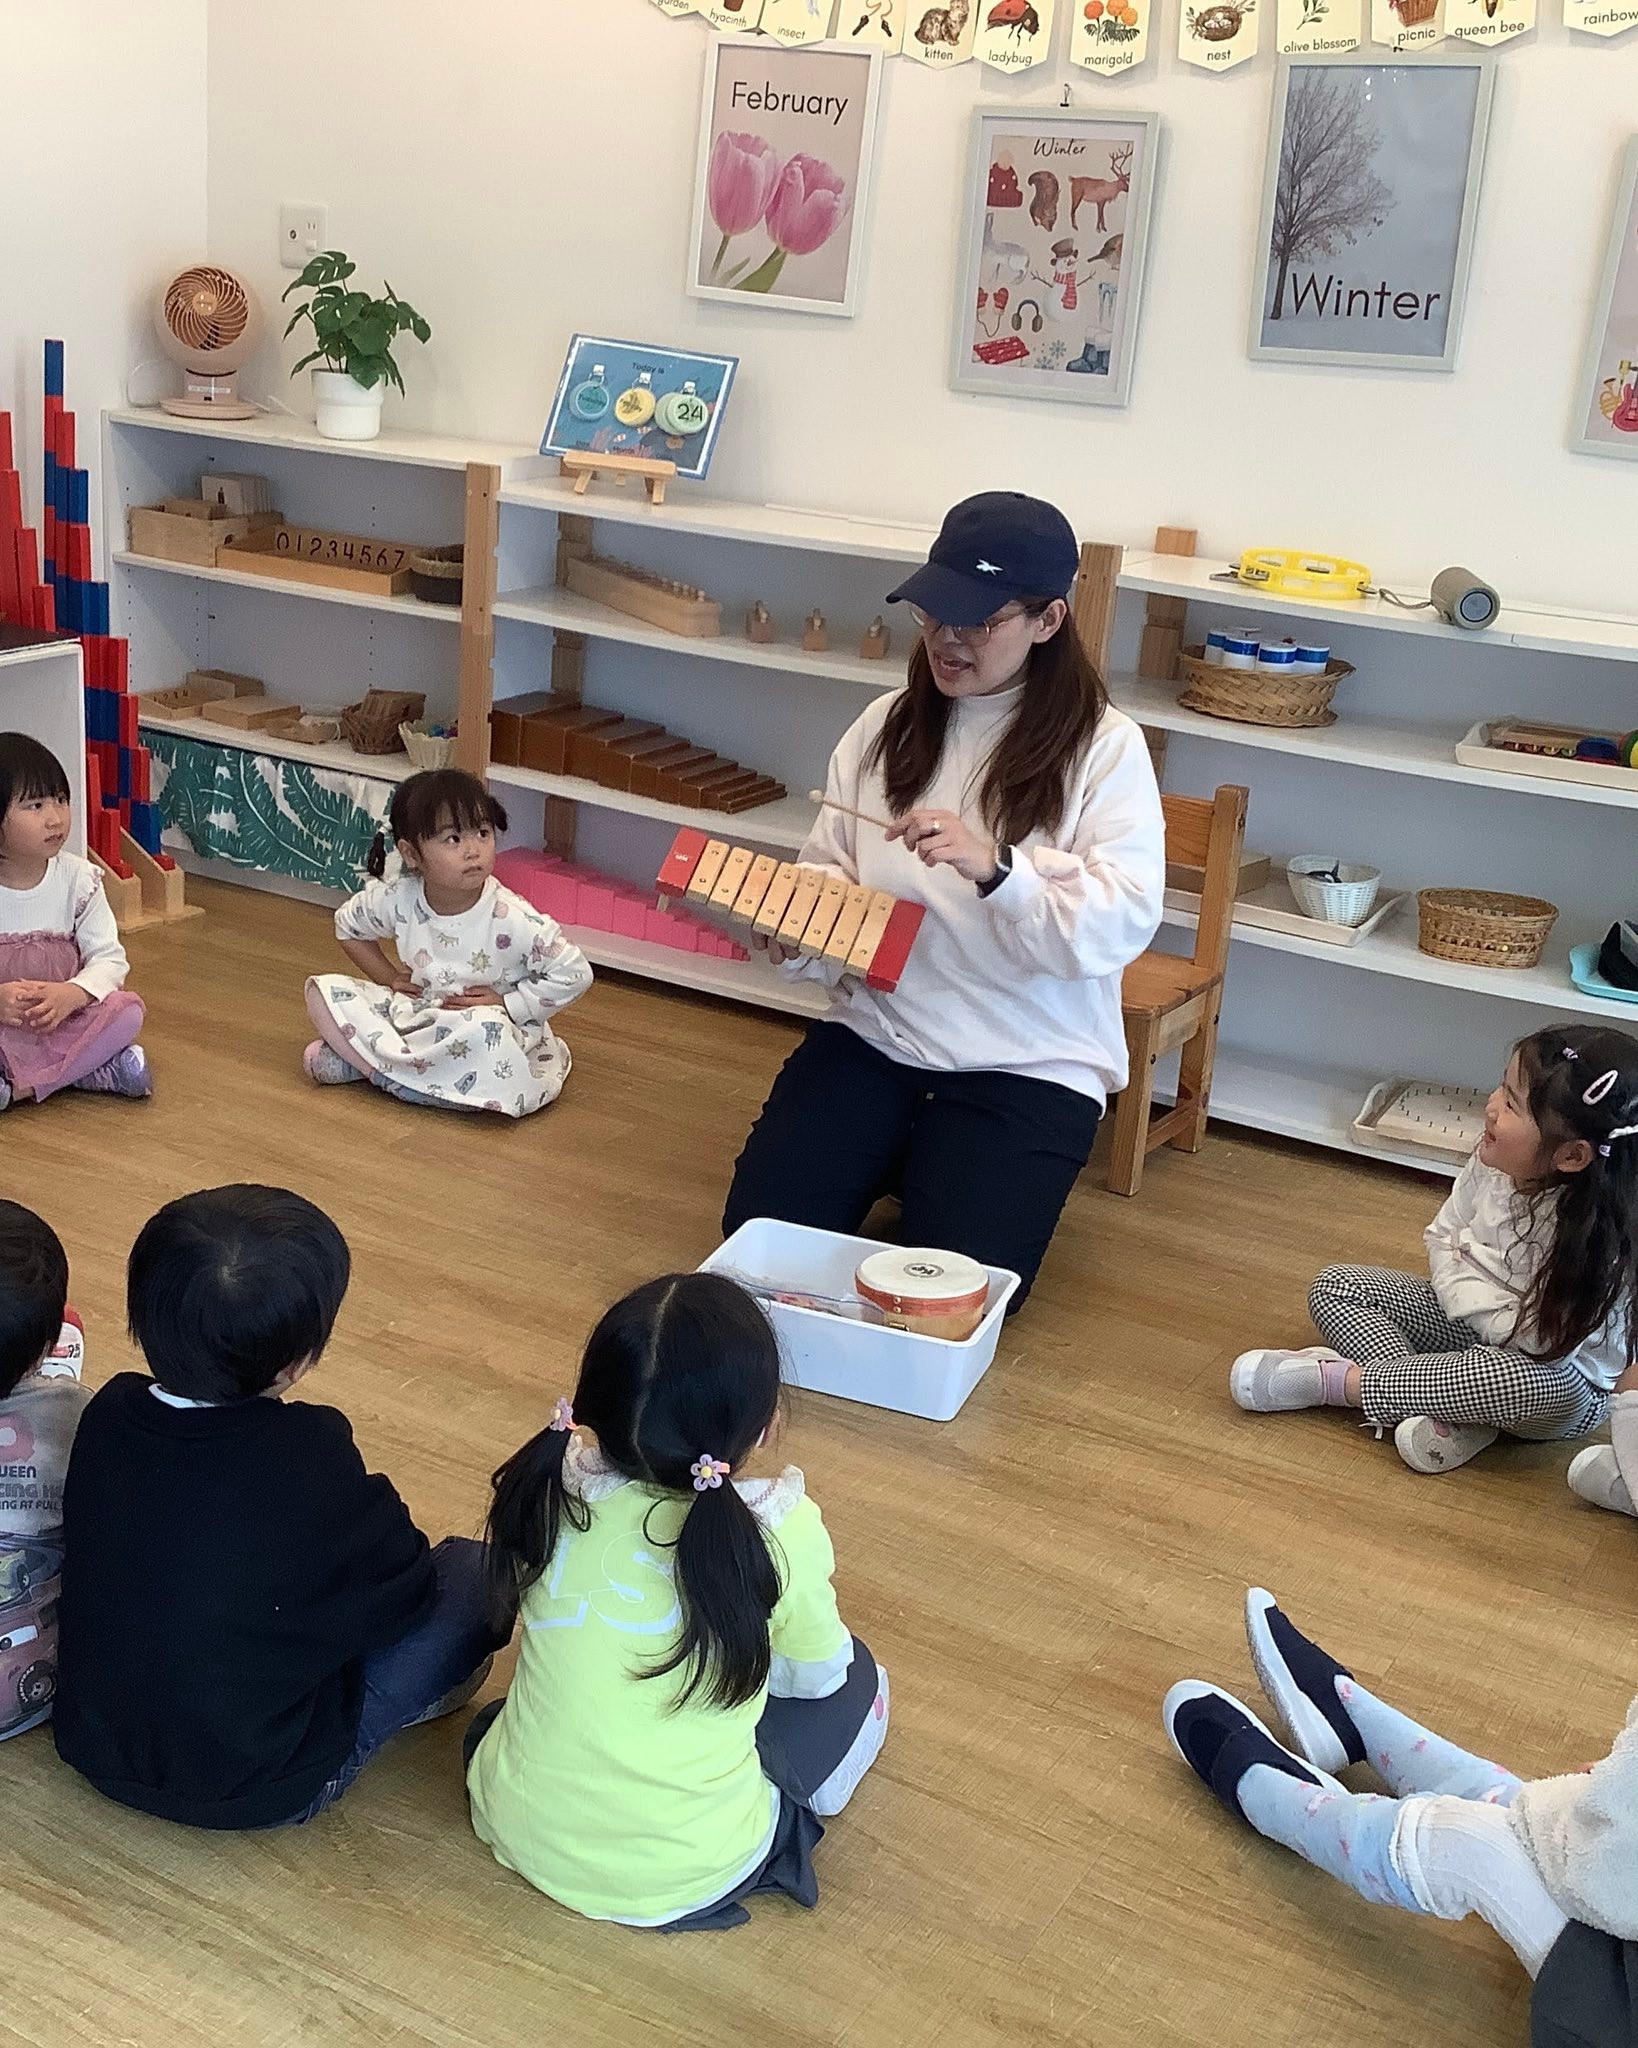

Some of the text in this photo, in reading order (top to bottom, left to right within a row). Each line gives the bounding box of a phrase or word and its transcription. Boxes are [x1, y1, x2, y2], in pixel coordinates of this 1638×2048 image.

[709, 8, 747, 27] hyacinth
[1584, 9, 1638, 25] rainbow
[777, 26, 806, 40] insect
[1398, 28, 1437, 45] picnic
[1455, 20, 1526, 39] queen bee
[924, 47, 954, 60] kitten
[1284, 37, 1357, 53] olive blossom
[988, 50, 1033, 67] ladybug
[1084, 52, 1133, 68] marigold
[1206, 50, 1231, 61] nest
[732, 81, 849, 125] February
[1033, 137, 1086, 157] Winter
[1292, 272, 1441, 321] Winter
[677, 403, 703, 422] 24
[20, 1500, 33, 1510] AT
